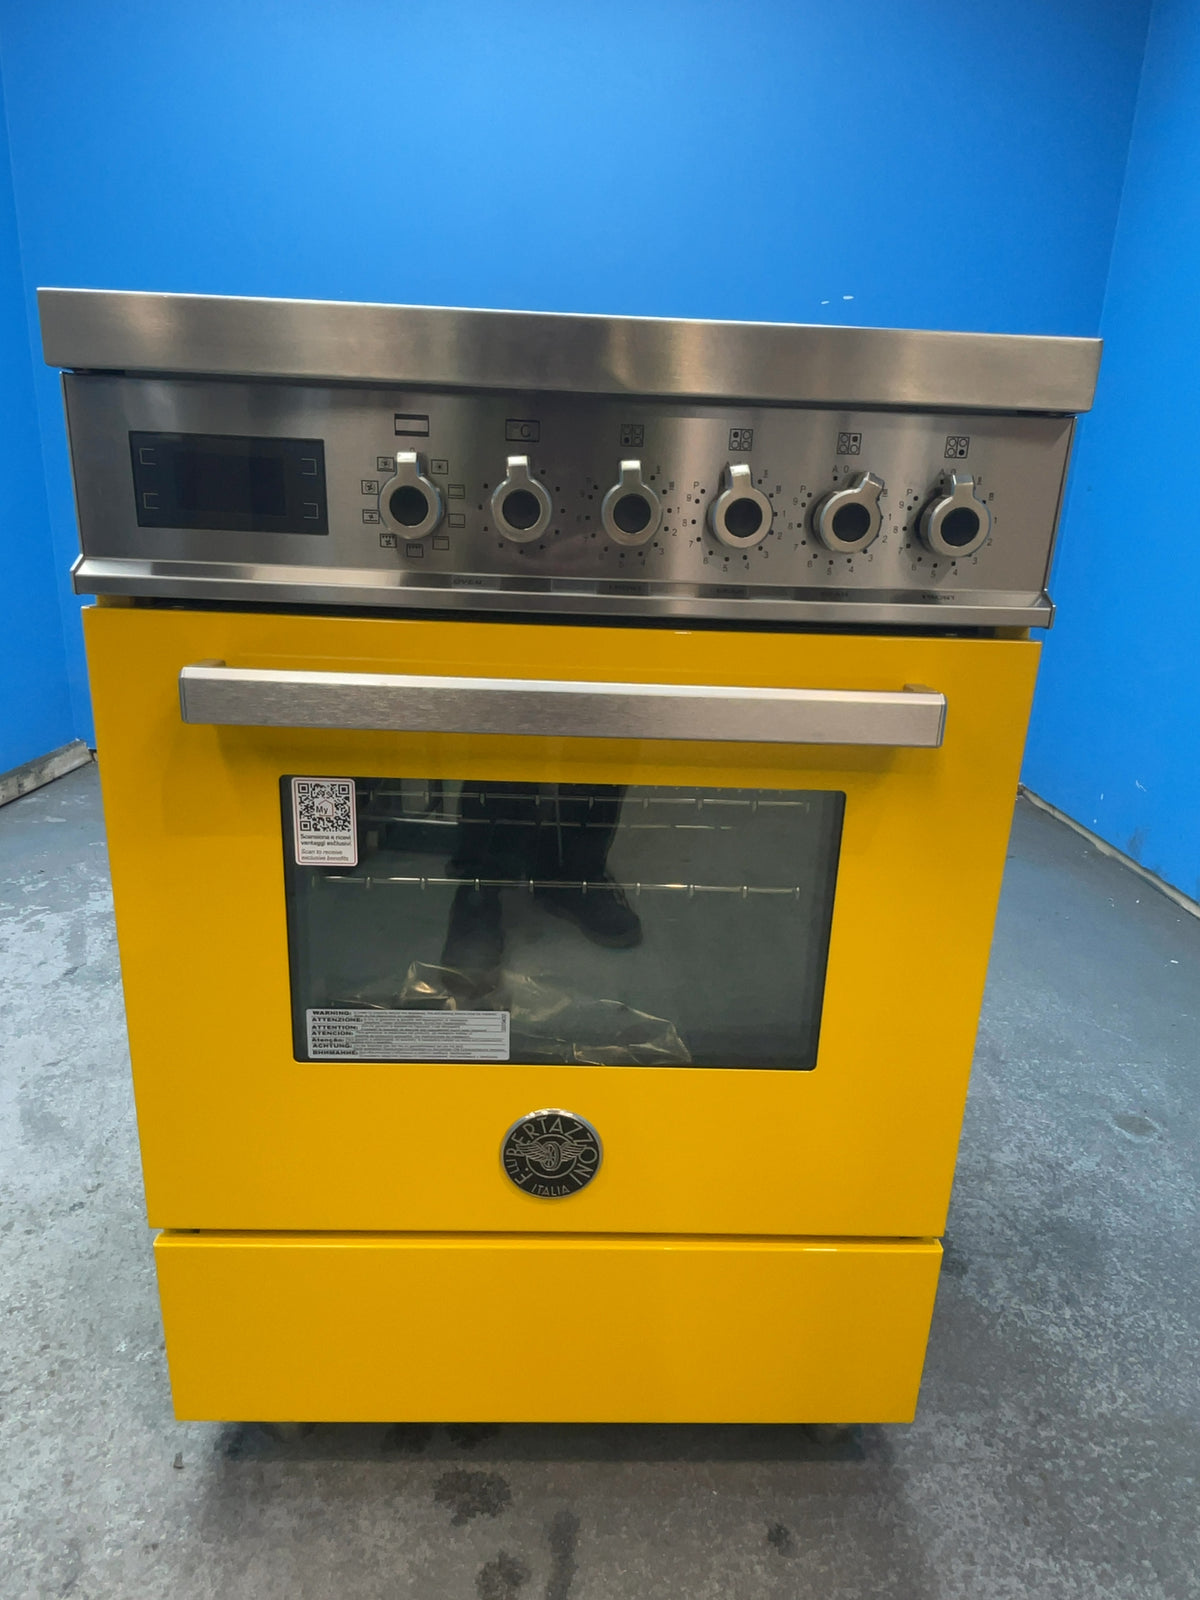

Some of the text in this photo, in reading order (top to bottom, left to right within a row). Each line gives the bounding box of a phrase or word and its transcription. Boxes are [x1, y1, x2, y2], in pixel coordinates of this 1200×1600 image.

[832, 464, 838, 473] A
[693, 481, 700, 489] P
[799, 485, 807, 493] P
[906, 488, 913, 497] P
[686, 494, 692, 503] 9
[898, 500, 905, 509] 9
[682, 519, 688, 527] 8
[672, 528, 678, 537] 2
[881, 534, 888, 543] 2
[986, 537, 993, 547] 2
[688, 540, 694, 548] 7
[793, 543, 799, 551] 7
[658, 547, 665, 555] 3
[763, 550, 769, 559] 3
[868, 554, 874, 562] 3
[971, 556, 978, 565] 3
[722, 564, 728, 572] 5
[744, 562, 750, 570] 4
[930, 570, 936, 578] 5
[952, 569, 958, 577] 4
[316, 806, 329, 814] My
[505, 1117, 598, 1186] BERTAZZONI
[531, 1184, 570, 1196] ITALIA
